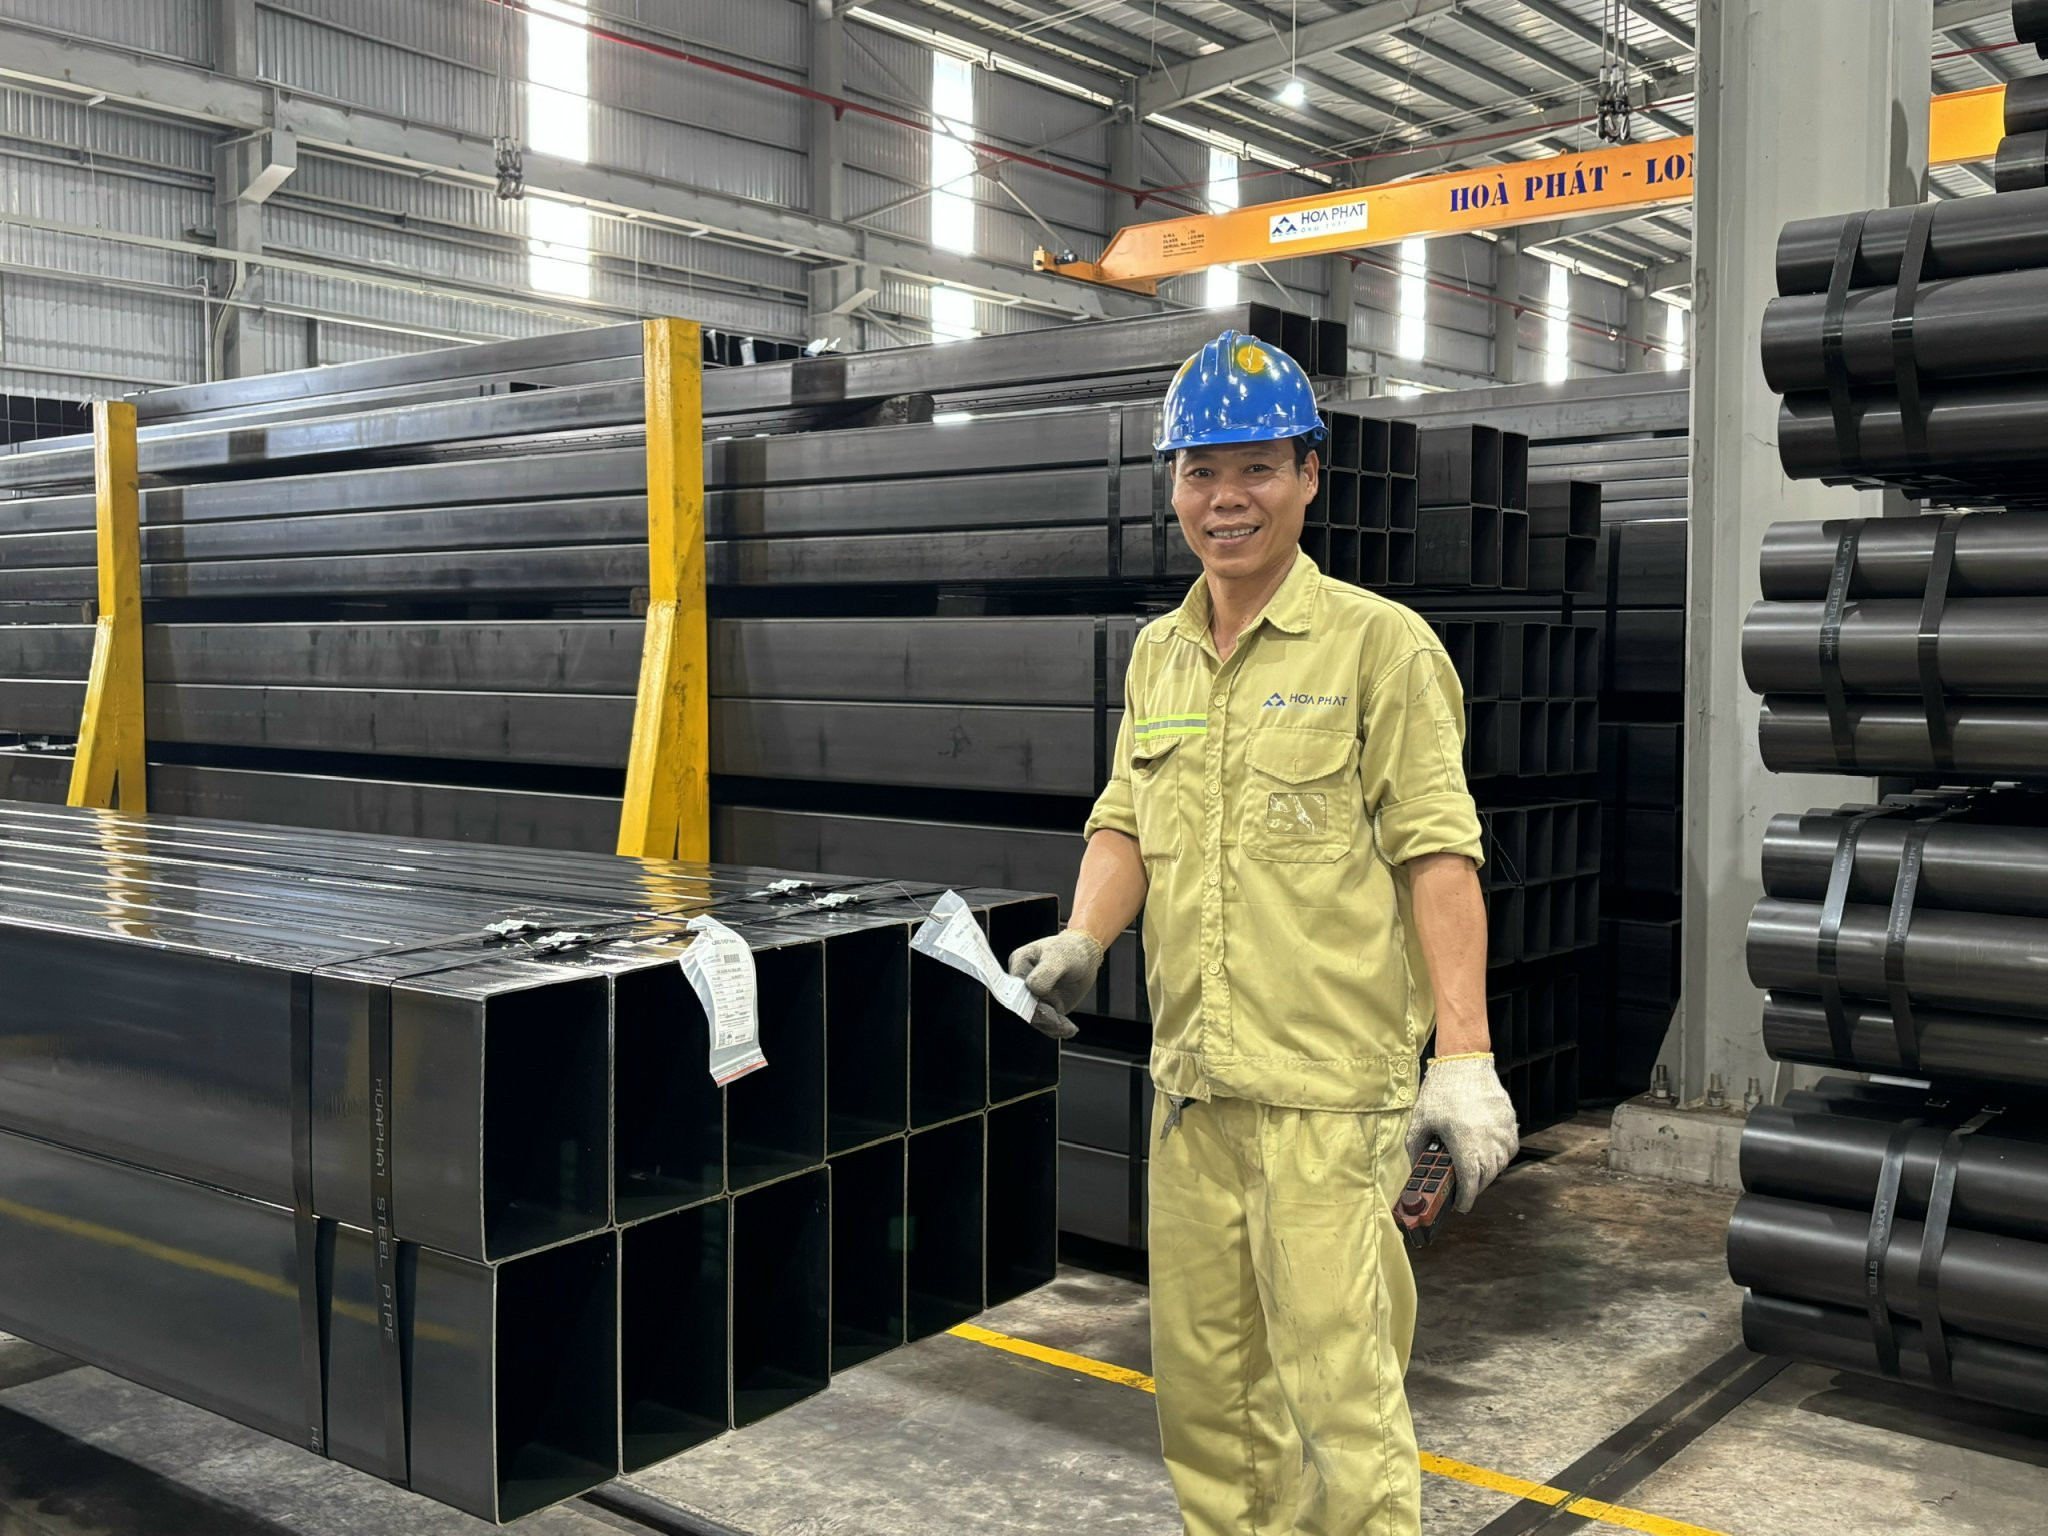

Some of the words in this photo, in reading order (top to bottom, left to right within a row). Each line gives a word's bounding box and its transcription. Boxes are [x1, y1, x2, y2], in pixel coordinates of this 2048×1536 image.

[1450, 173, 1510, 212] HOÀ
[1524, 161, 1609, 202] PHÁT
[376, 1197, 389, 1268] STEEL
[381, 1282, 395, 1343] PIPE
